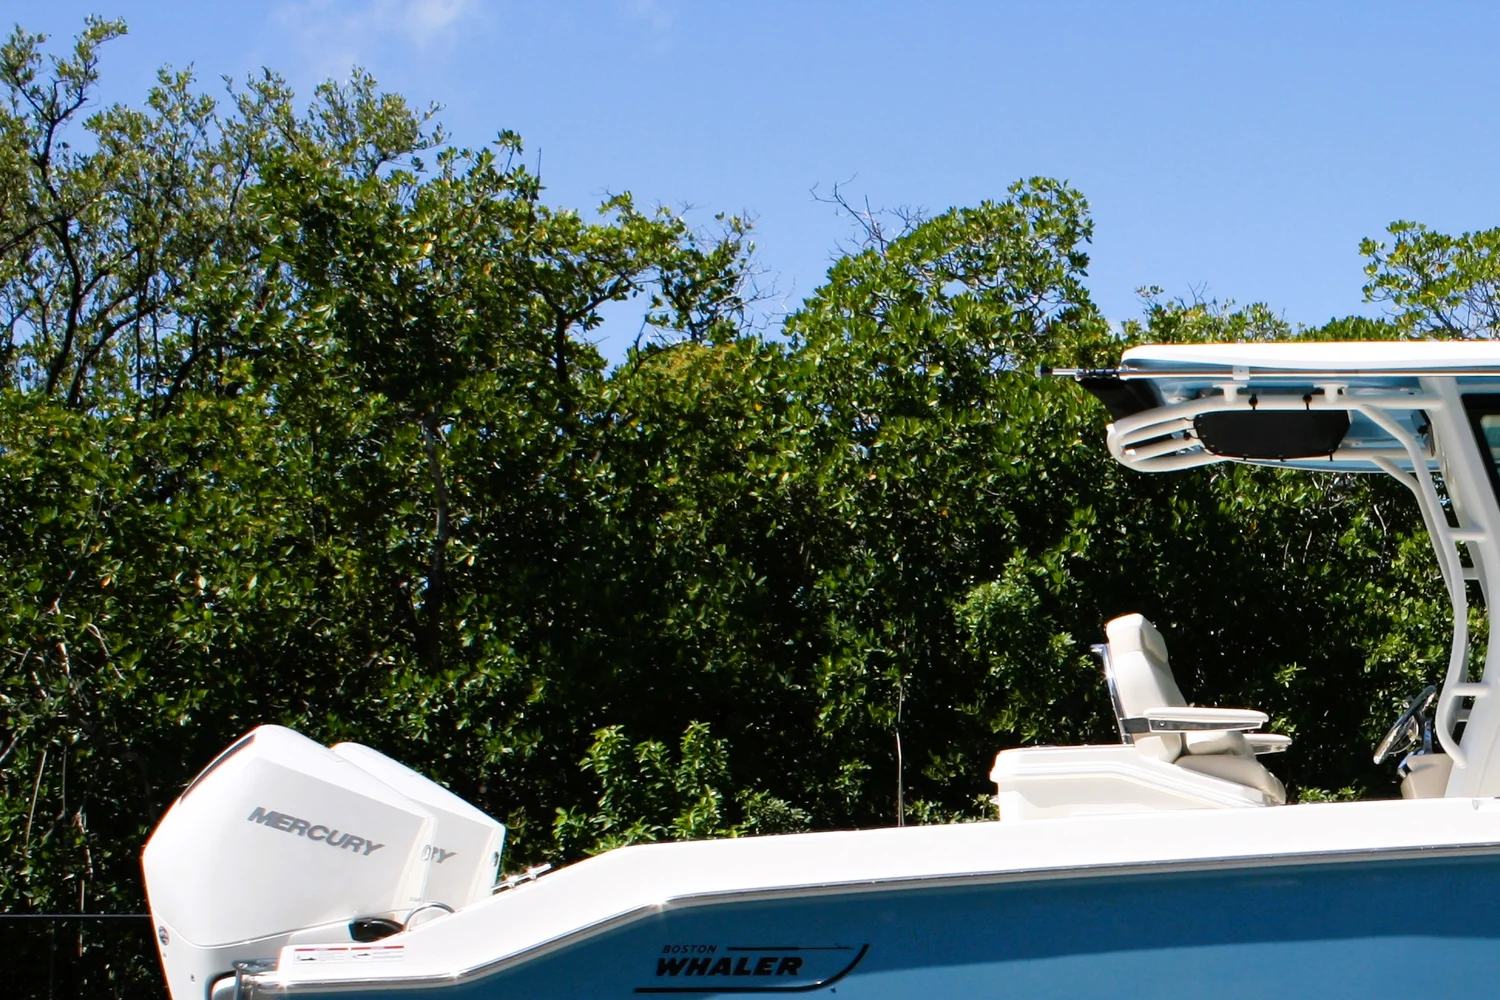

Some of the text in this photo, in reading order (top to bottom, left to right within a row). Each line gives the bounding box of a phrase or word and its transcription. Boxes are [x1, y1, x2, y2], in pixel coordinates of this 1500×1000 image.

[247, 806, 385, 856] MERCURY
[662, 944, 717, 954] BOSTON
[655, 956, 803, 977] WHALER
